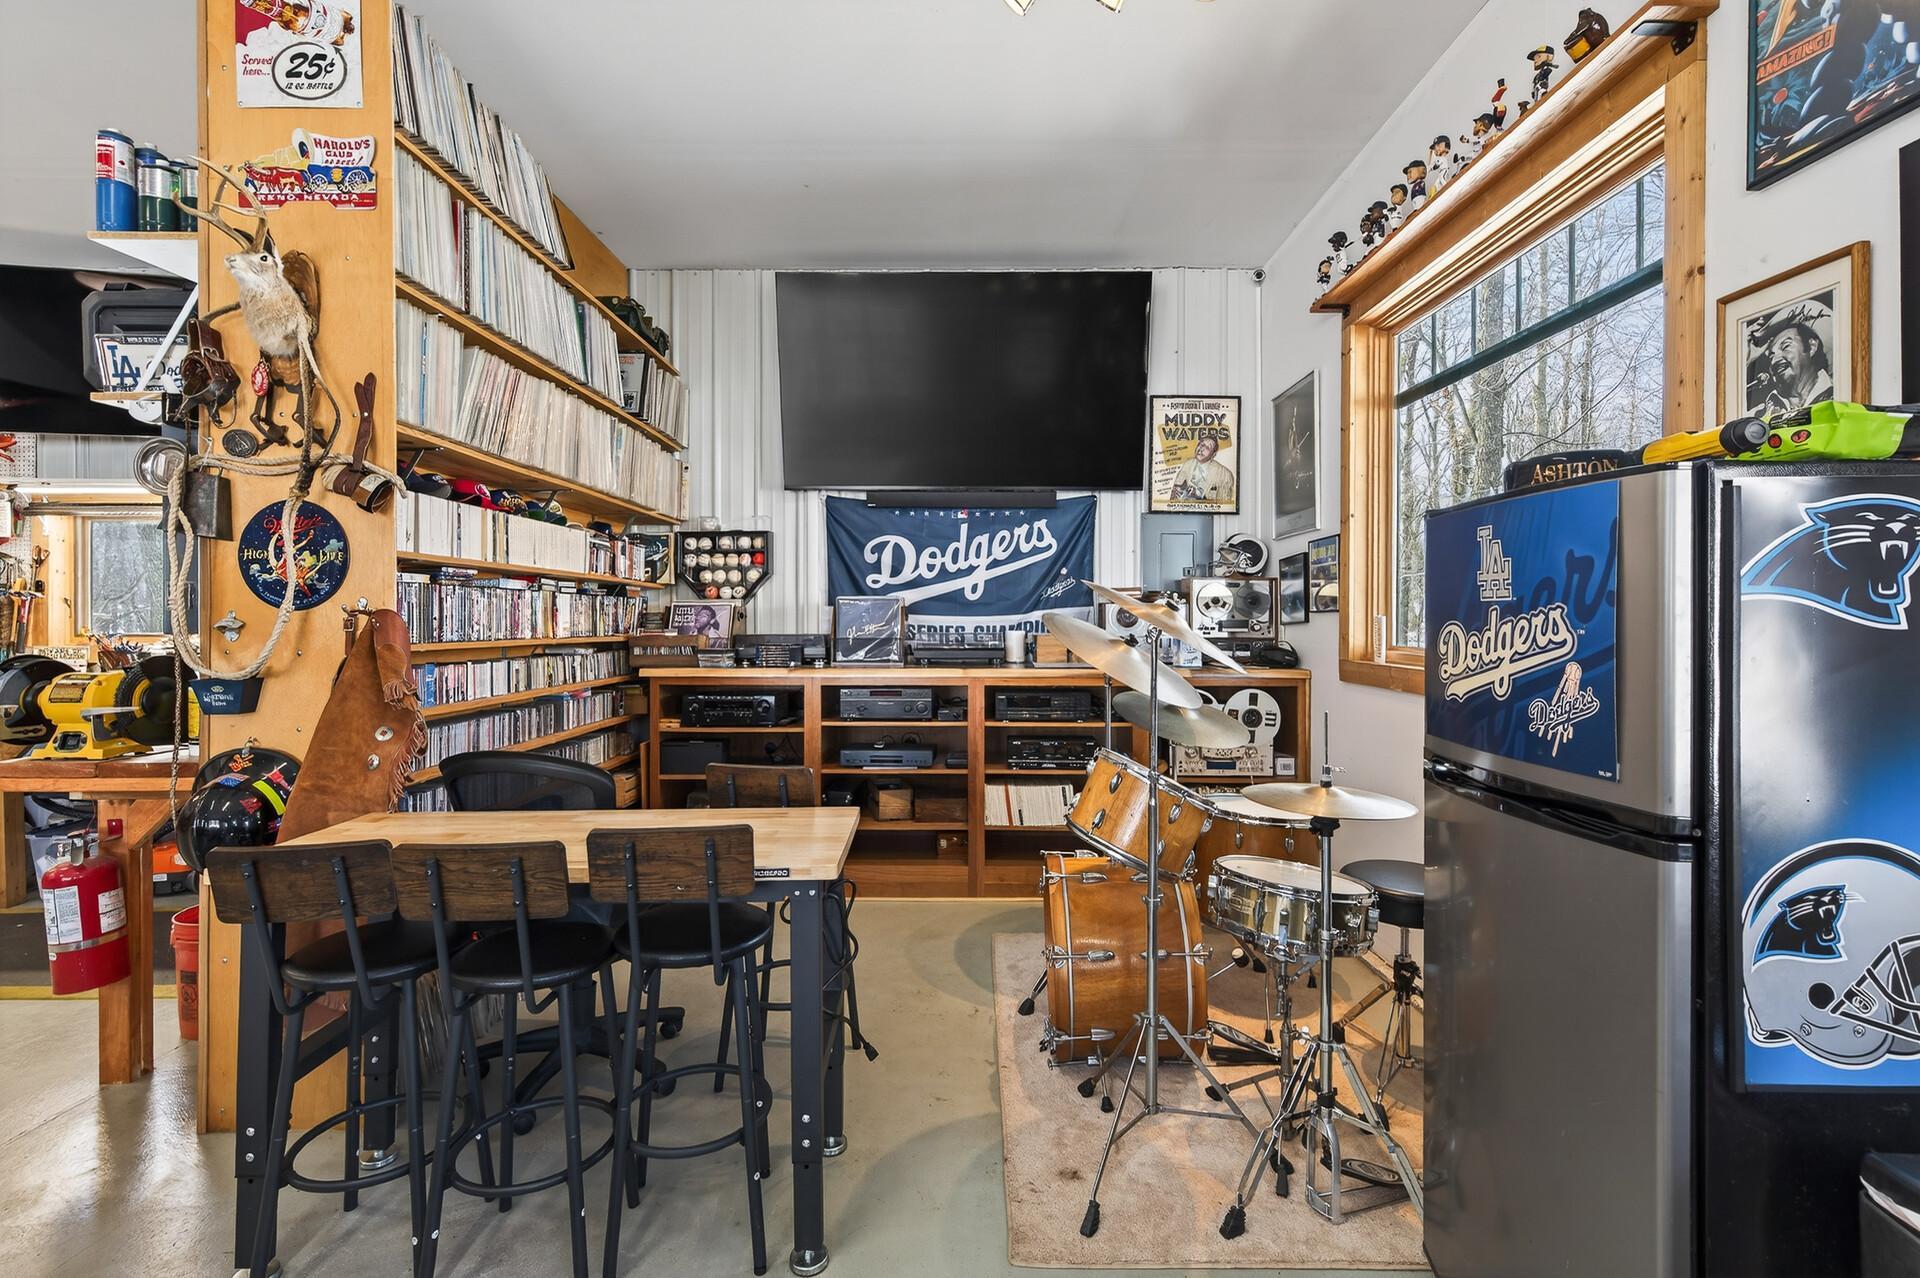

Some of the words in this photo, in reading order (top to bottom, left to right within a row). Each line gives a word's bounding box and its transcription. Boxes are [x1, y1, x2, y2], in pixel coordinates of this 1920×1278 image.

[285, 52, 336, 80] 25¢
[1758, 29, 1833, 79] AMAZING!
[313, 138, 371, 150] HAROLD'S
[304, 193, 360, 201] NEVADA
[1162, 427, 1230, 441] WATERS
[1165, 413, 1227, 427] MUDDY
[1530, 457, 1618, 486] ASHTON
[864, 518, 1058, 606] Dodgers
[1477, 525, 1512, 601] LA
[1438, 603, 1577, 702] Dodgers
